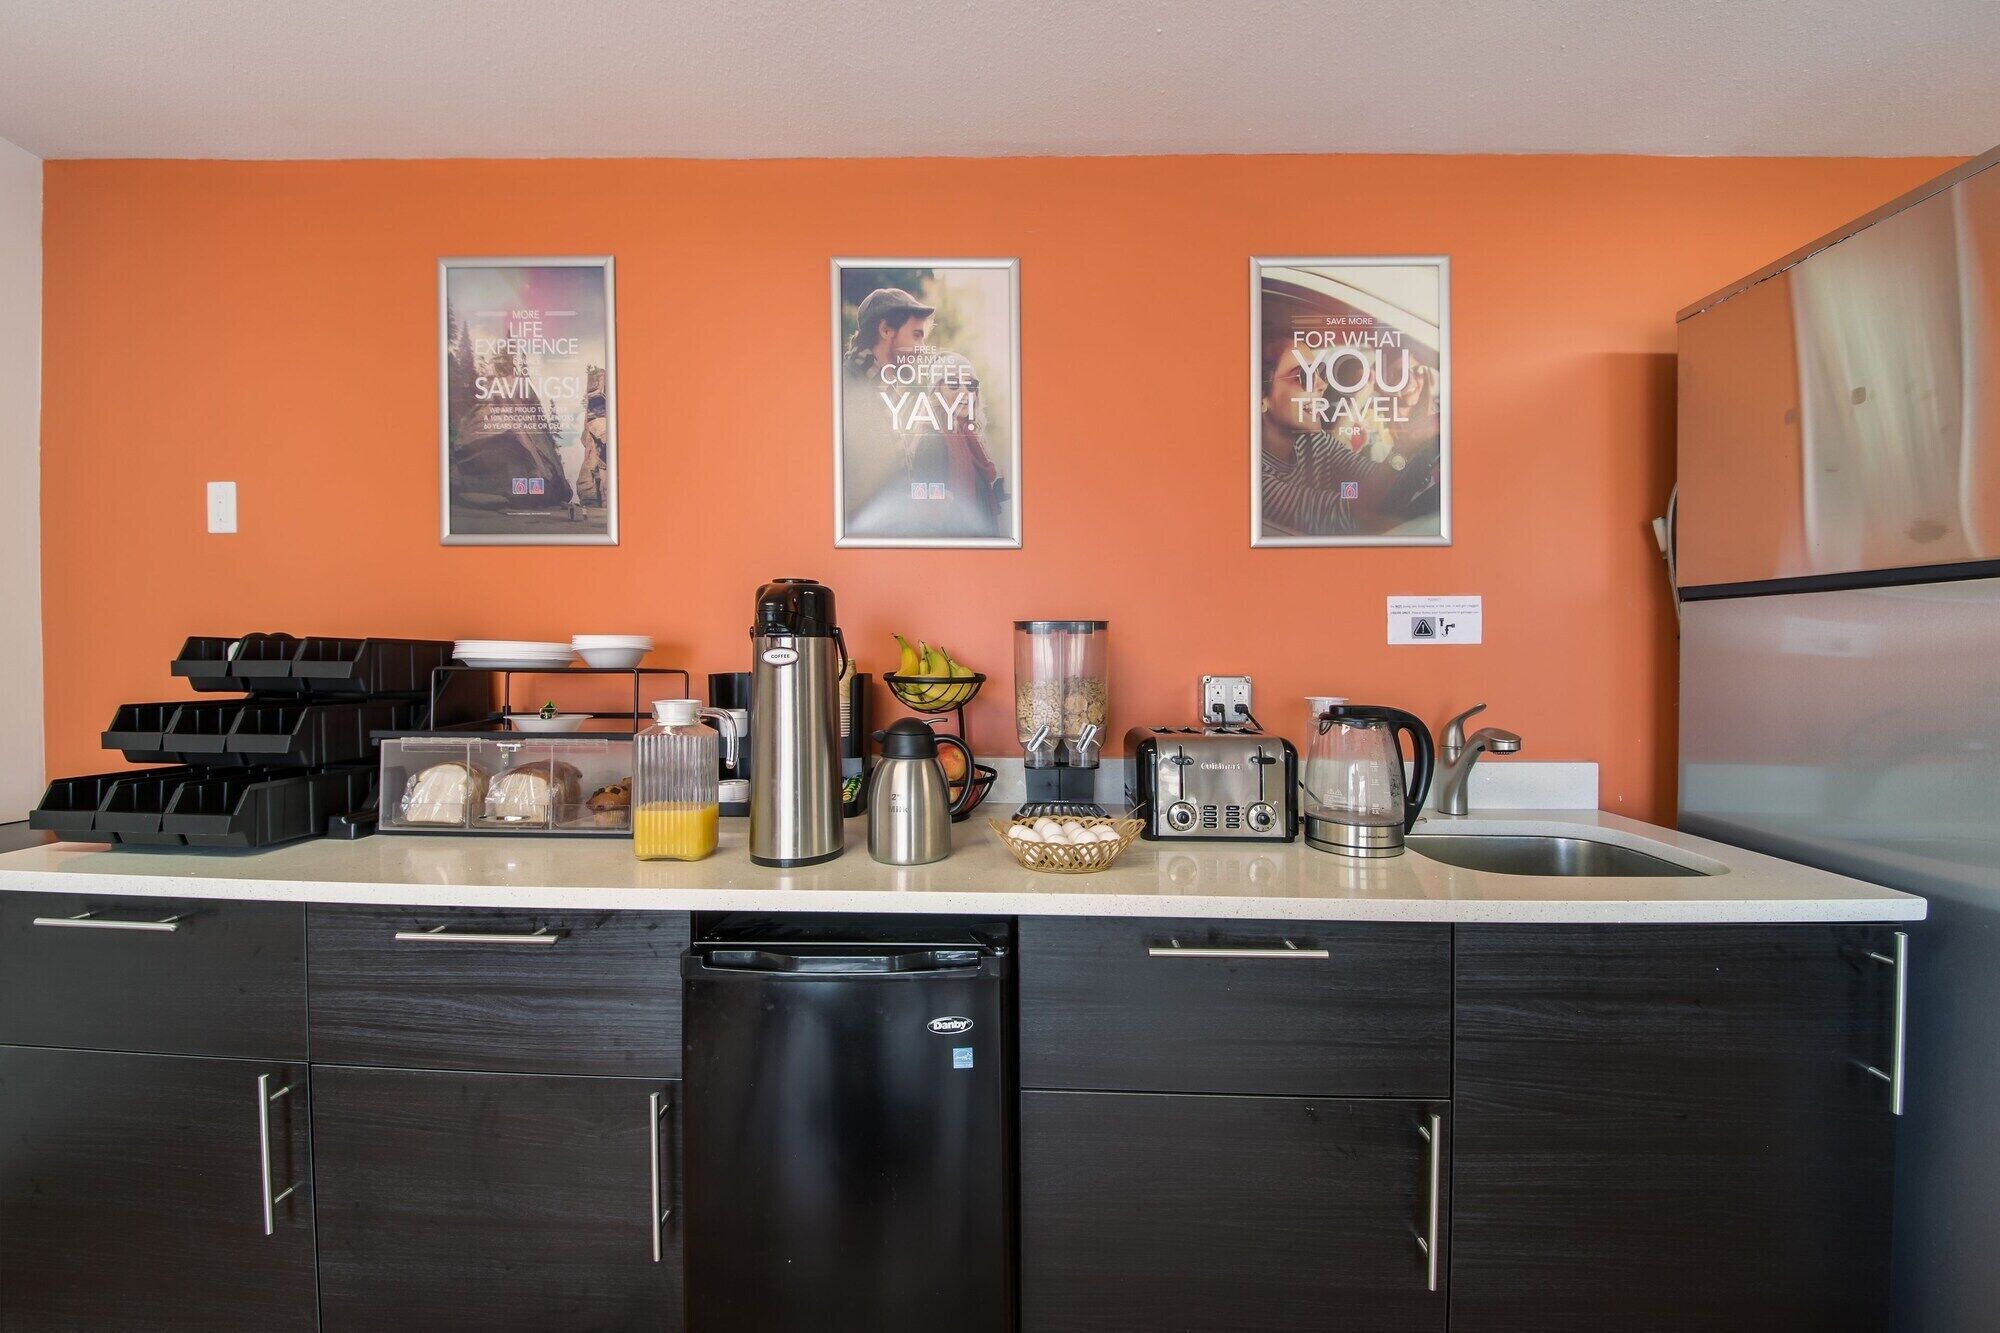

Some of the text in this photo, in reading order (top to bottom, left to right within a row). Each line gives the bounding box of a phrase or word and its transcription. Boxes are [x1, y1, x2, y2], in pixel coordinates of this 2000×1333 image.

[512, 310, 540, 319] MORE
[1326, 317, 1373, 325] SAVE MORE
[509, 321, 543, 338] LIFE
[475, 338, 579, 355] EXPERIENCE
[1294, 331, 1404, 348] FOR WHAT
[914, 346, 937, 354] FREE
[896, 355, 957, 364] MORNING
[880, 364, 972, 385] COFFEE
[1291, 349, 1409, 393] YOU
[474, 376, 580, 400] SAVINGS!
[880, 391, 975, 431] YAY!
[1291, 397, 1409, 423] TRAVEL
[1339, 427, 1360, 436] FOR
[933, 1020, 967, 1031] Danby
